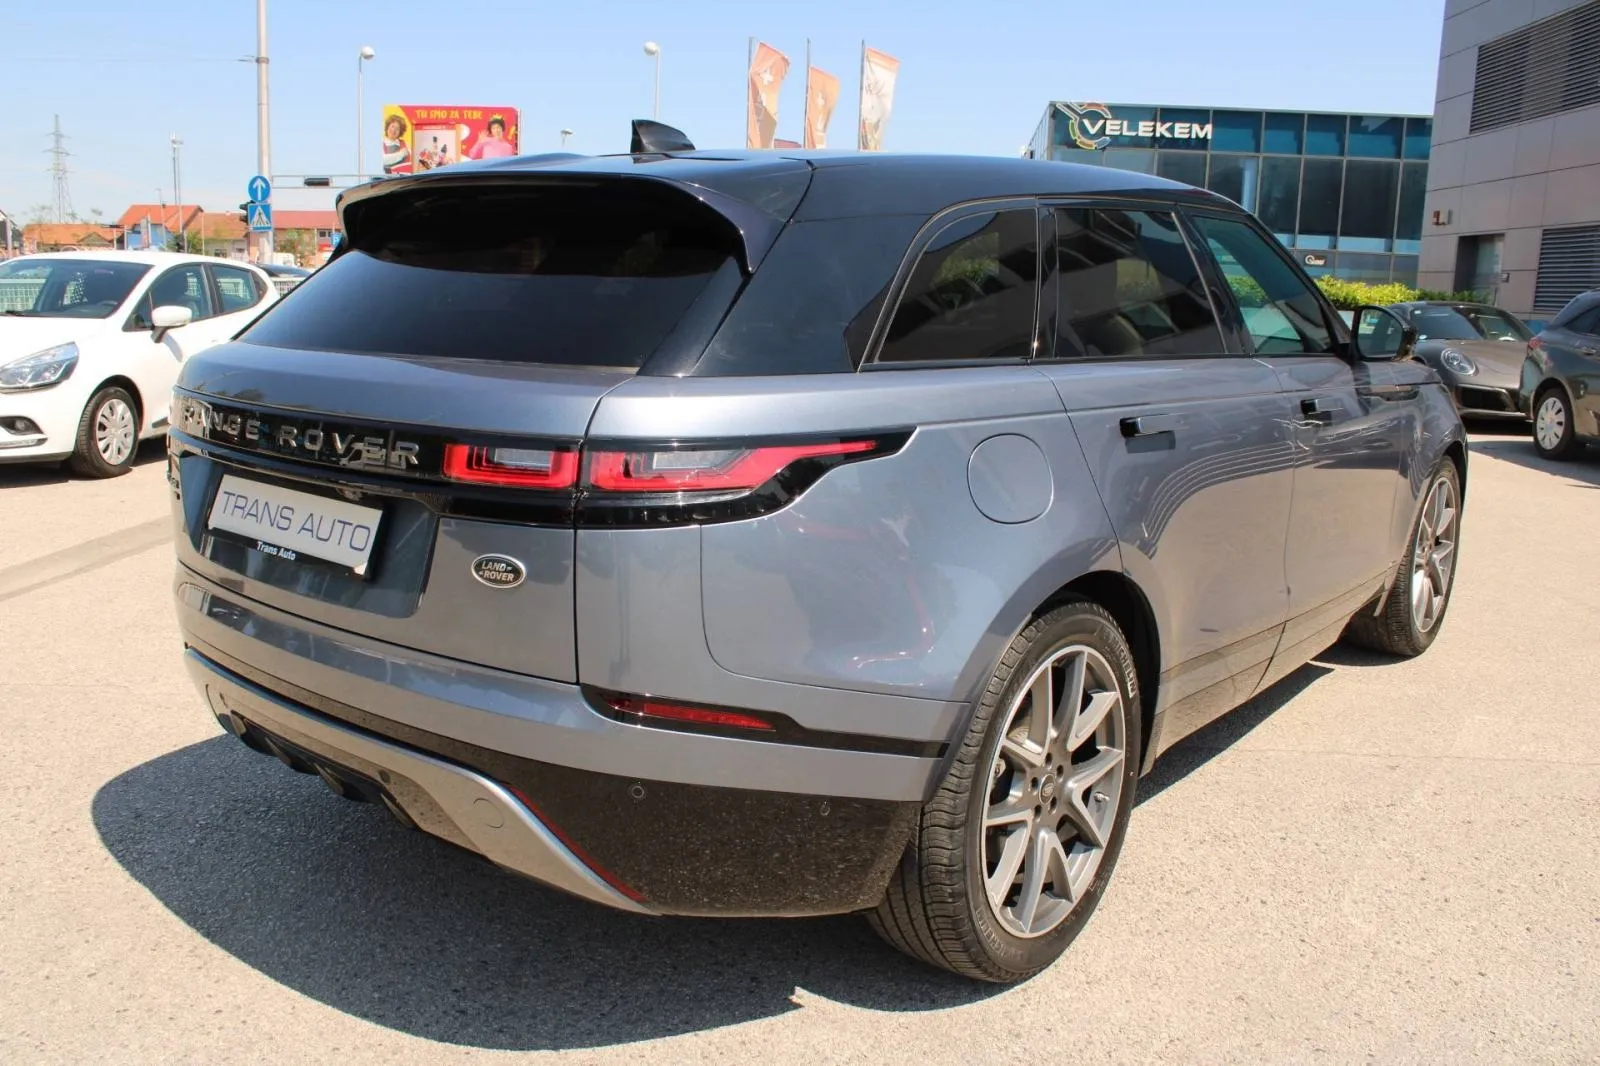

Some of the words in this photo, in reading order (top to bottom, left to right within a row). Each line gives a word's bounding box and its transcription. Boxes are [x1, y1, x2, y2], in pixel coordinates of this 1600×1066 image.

[1083, 118, 1213, 140] VELEKEM
[183, 405, 261, 440] RANGE
[279, 424, 420, 465] ROVER
[223, 491, 295, 531] TRANS
[297, 513, 372, 552] AUTO
[257, 541, 278, 556] Trans
[278, 546, 296, 560] Auto
[483, 570, 515, 582] ROVER
